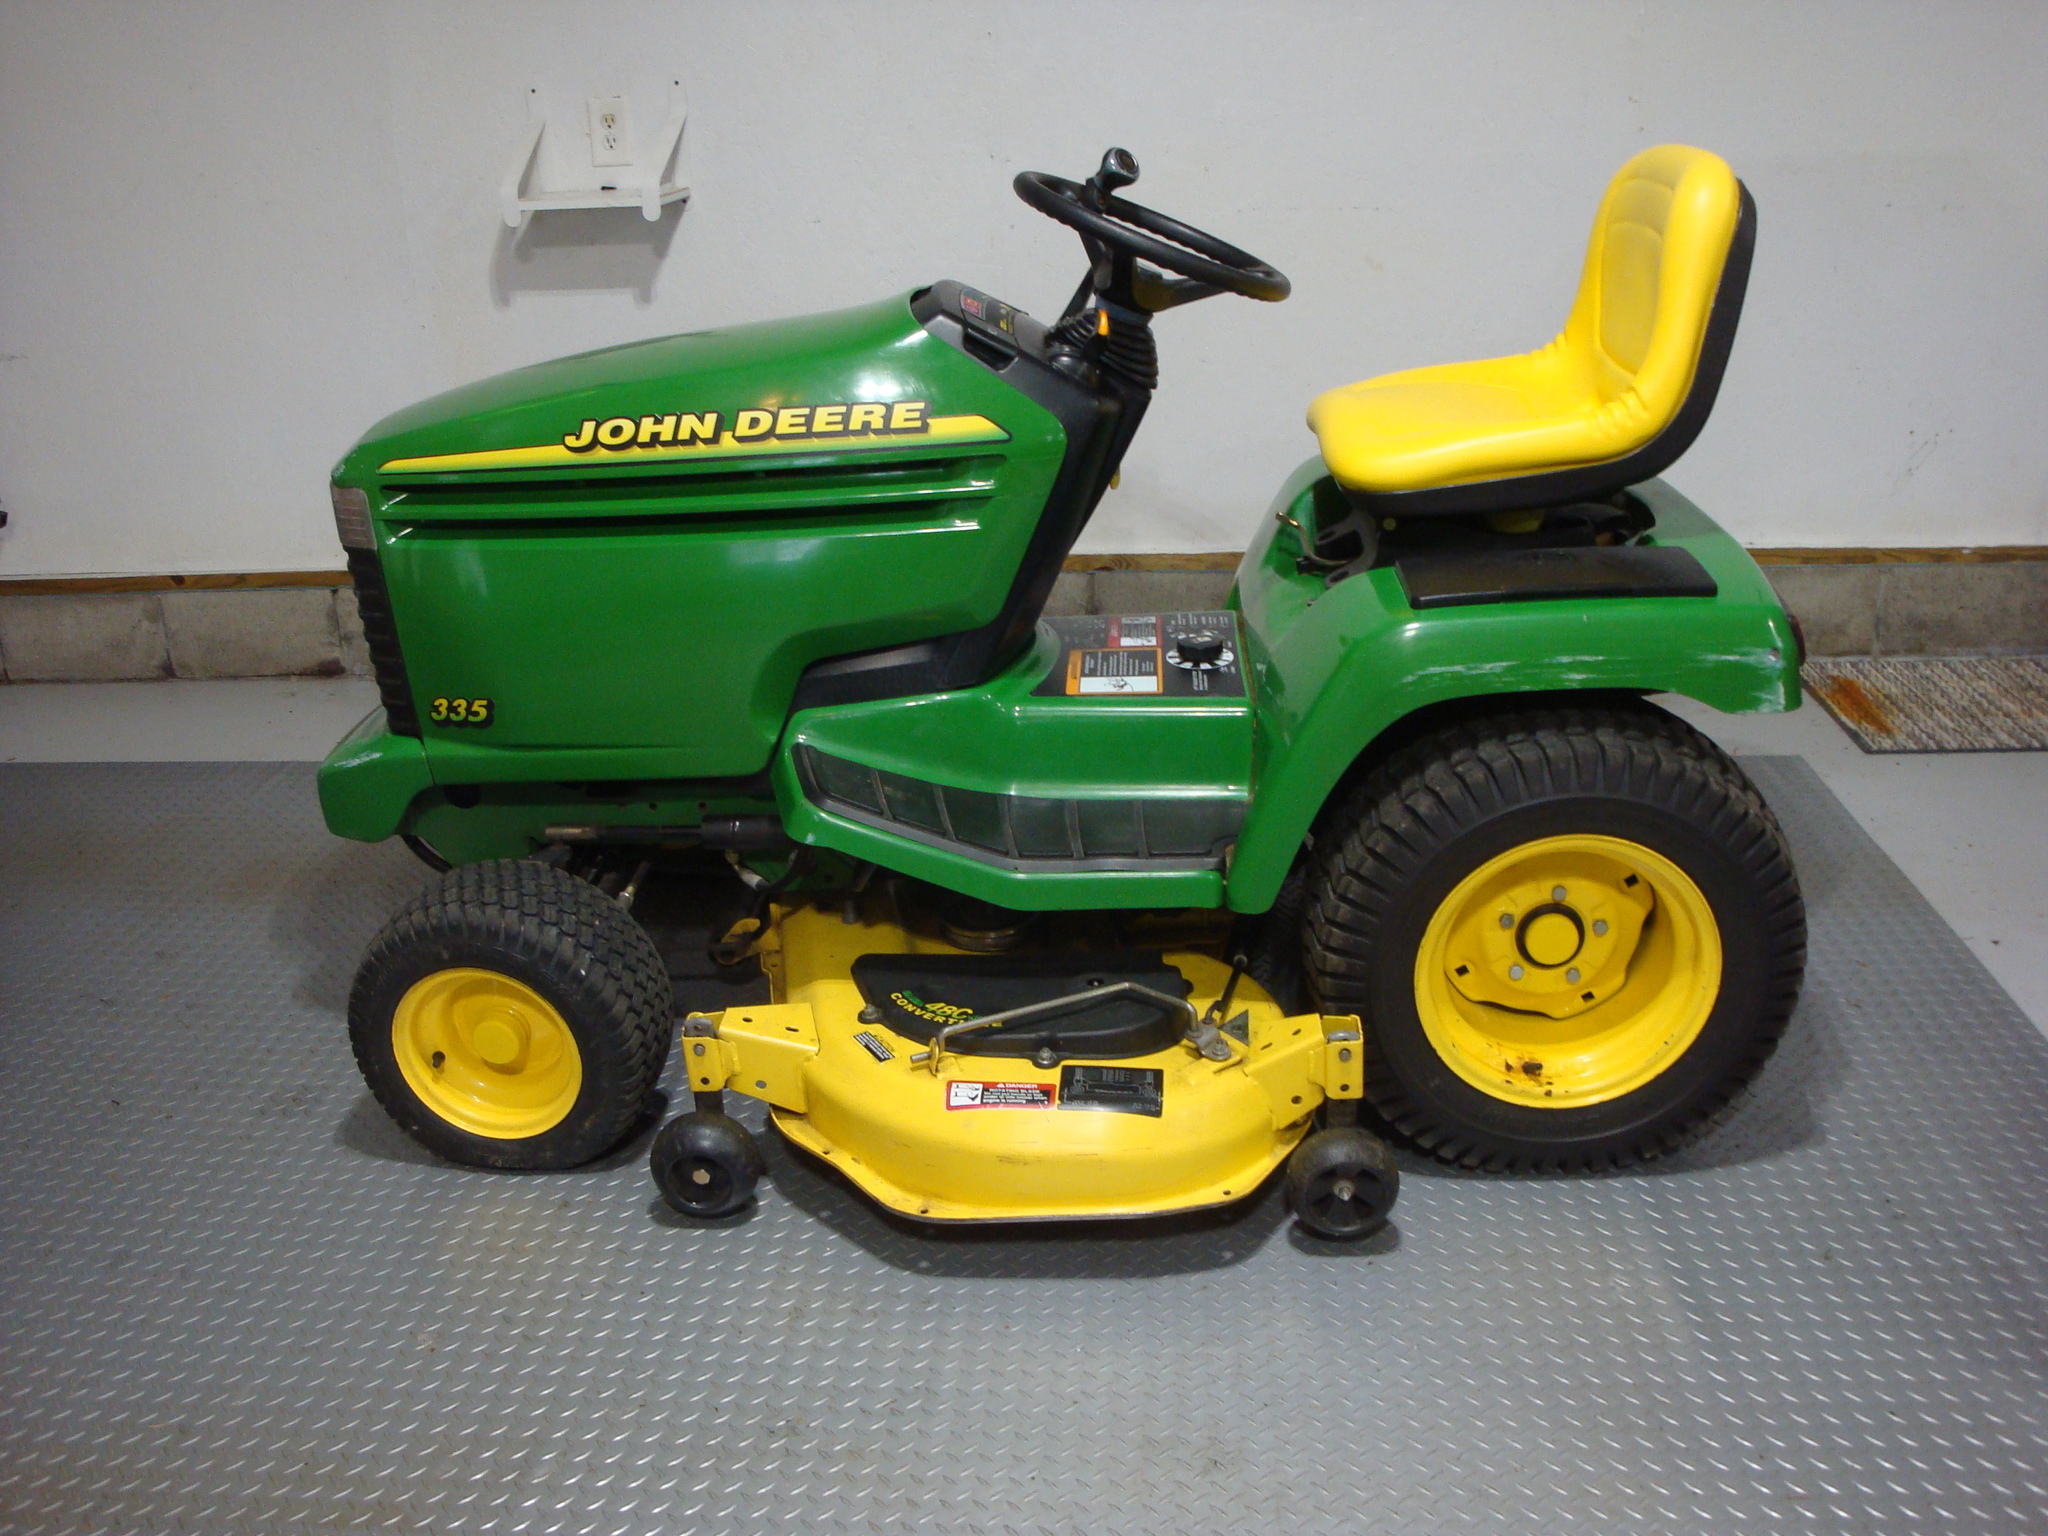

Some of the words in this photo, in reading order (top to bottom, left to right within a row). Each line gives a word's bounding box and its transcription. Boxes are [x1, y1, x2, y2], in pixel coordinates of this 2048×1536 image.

[563, 412, 722, 450] JOHN
[733, 402, 929, 440] DEERE
[430, 697, 491, 724] 335
[924, 1002, 974, 1020] 48C
